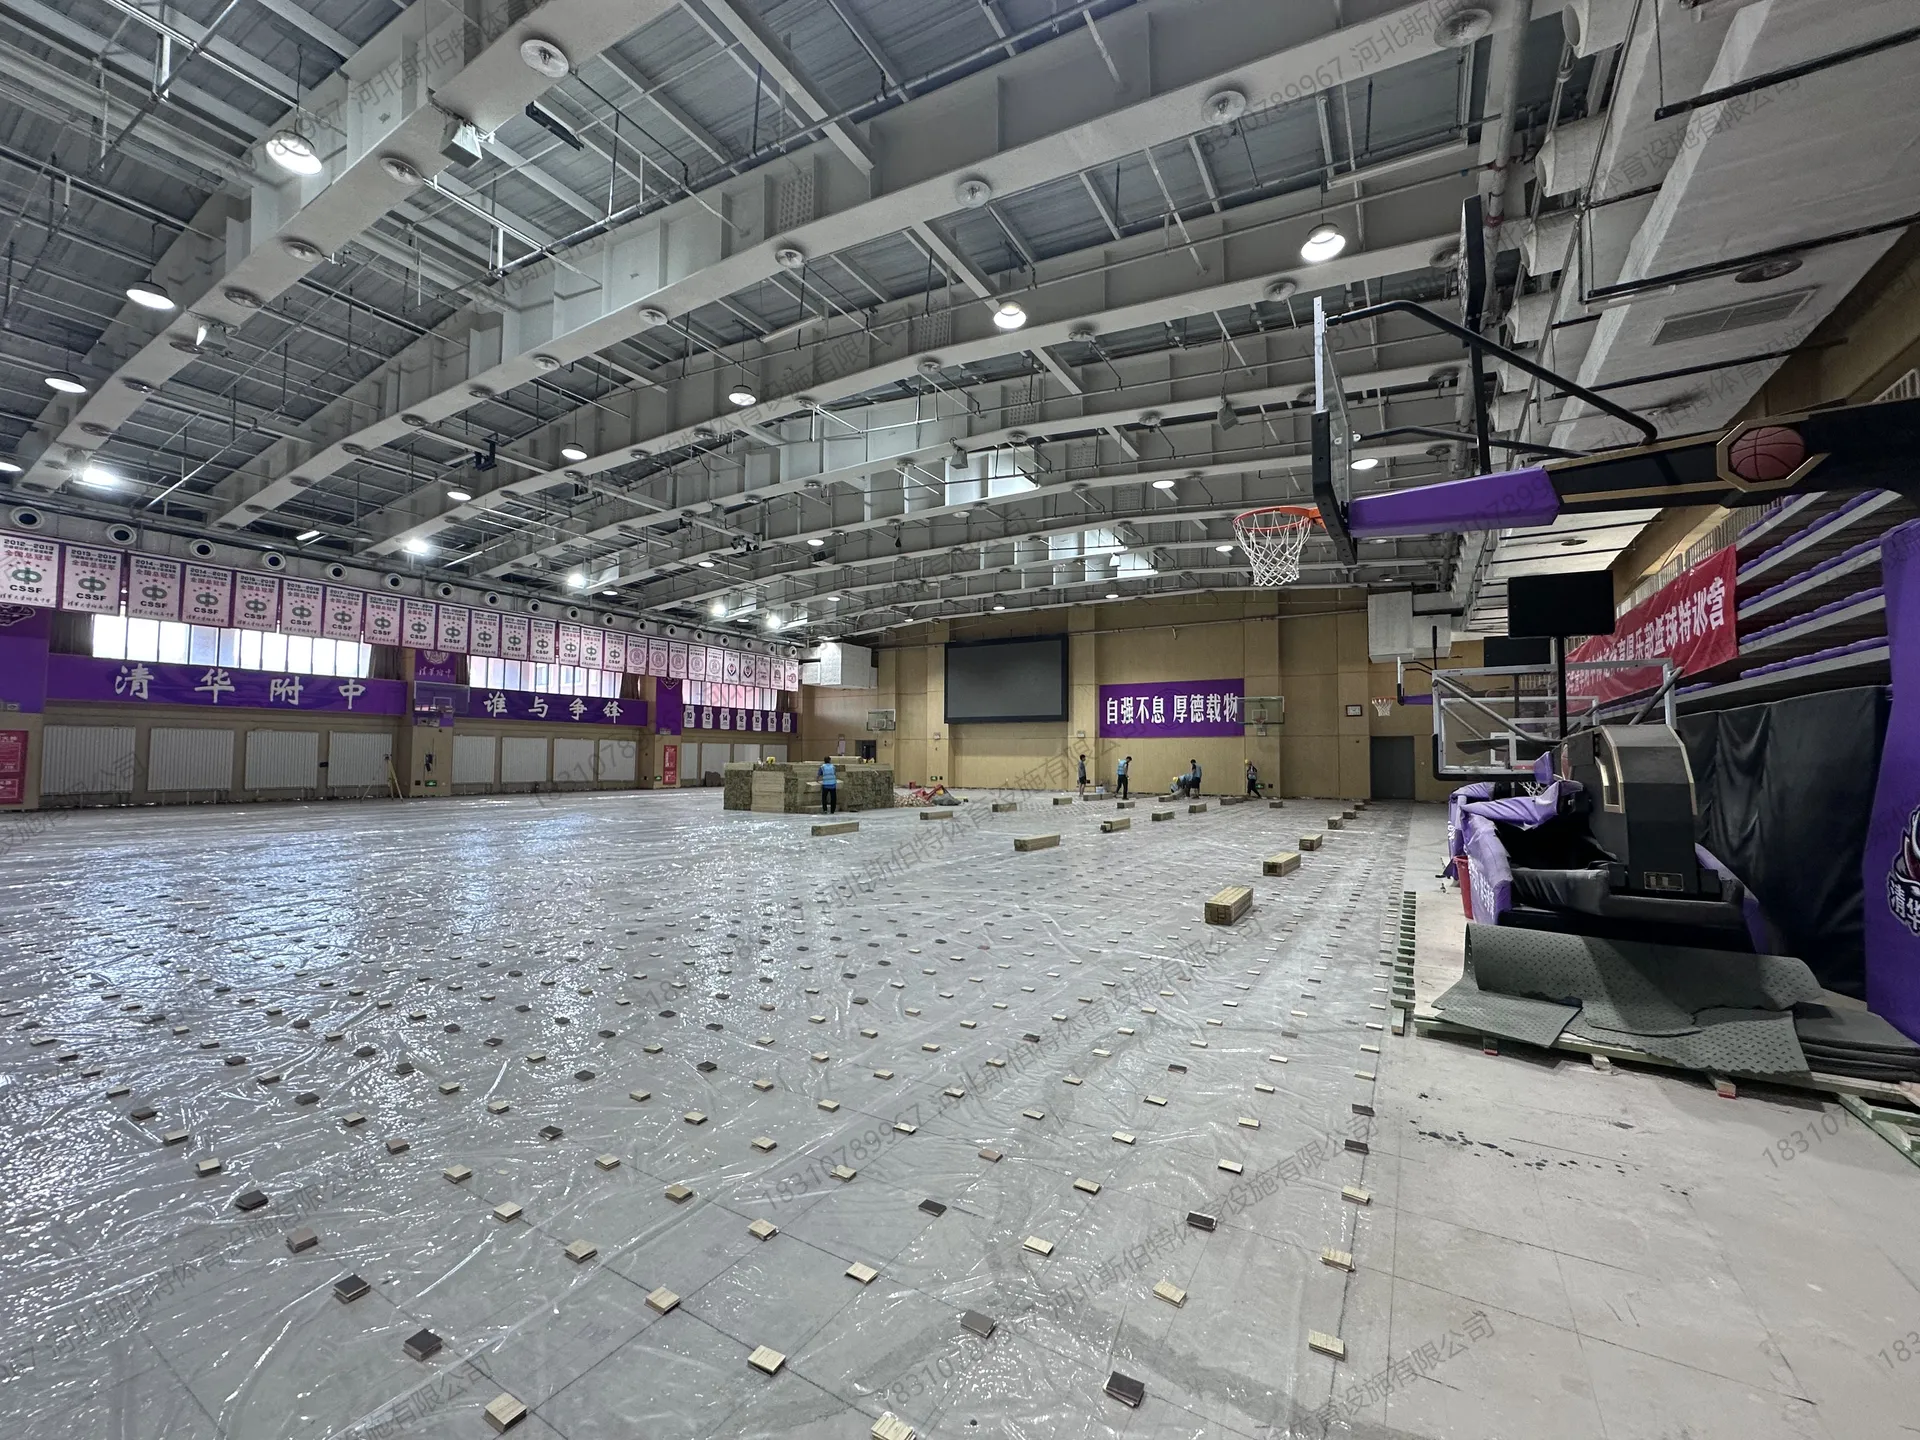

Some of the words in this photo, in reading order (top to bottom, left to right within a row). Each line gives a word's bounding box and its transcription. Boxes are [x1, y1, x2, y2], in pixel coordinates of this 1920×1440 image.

[4, 549, 53, 562] 全国总冠军
[72, 559, 116, 571] 全国总冠军
[136, 568, 176, 580] 全国总冠军
[9, 584, 43, 594] CSSF
[76, 592, 107, 601] CSSF
[140, 600, 168, 608] CSSF
[193, 607, 220, 615] CSSF
[332, 623, 353, 631] CSSF
[114, 663, 367, 711] 清华附中
[482, 690, 624, 725] 谁与争锋
[1105, 694, 1165, 725] 自强不息
[1172, 692, 1239, 724] 厚德载物
